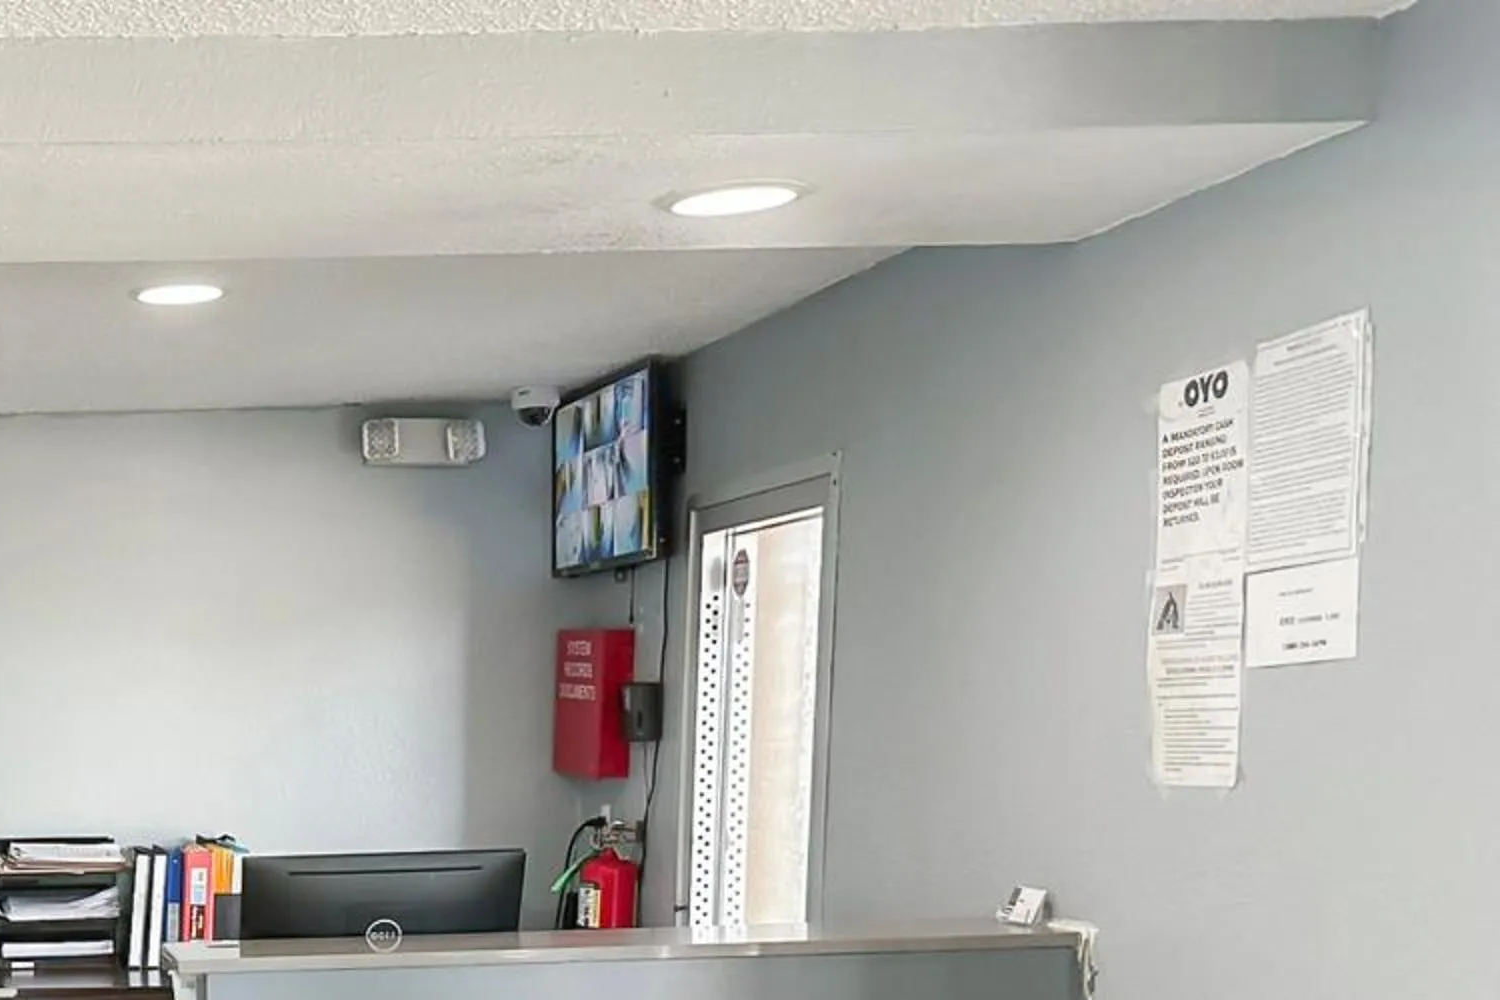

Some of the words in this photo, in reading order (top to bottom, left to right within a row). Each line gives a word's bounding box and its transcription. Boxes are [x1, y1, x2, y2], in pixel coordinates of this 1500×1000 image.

[1184, 370, 1229, 408] OYO
[566, 640, 592, 656] SYSTEM
[559, 683, 596, 701] DOCUMENTS
